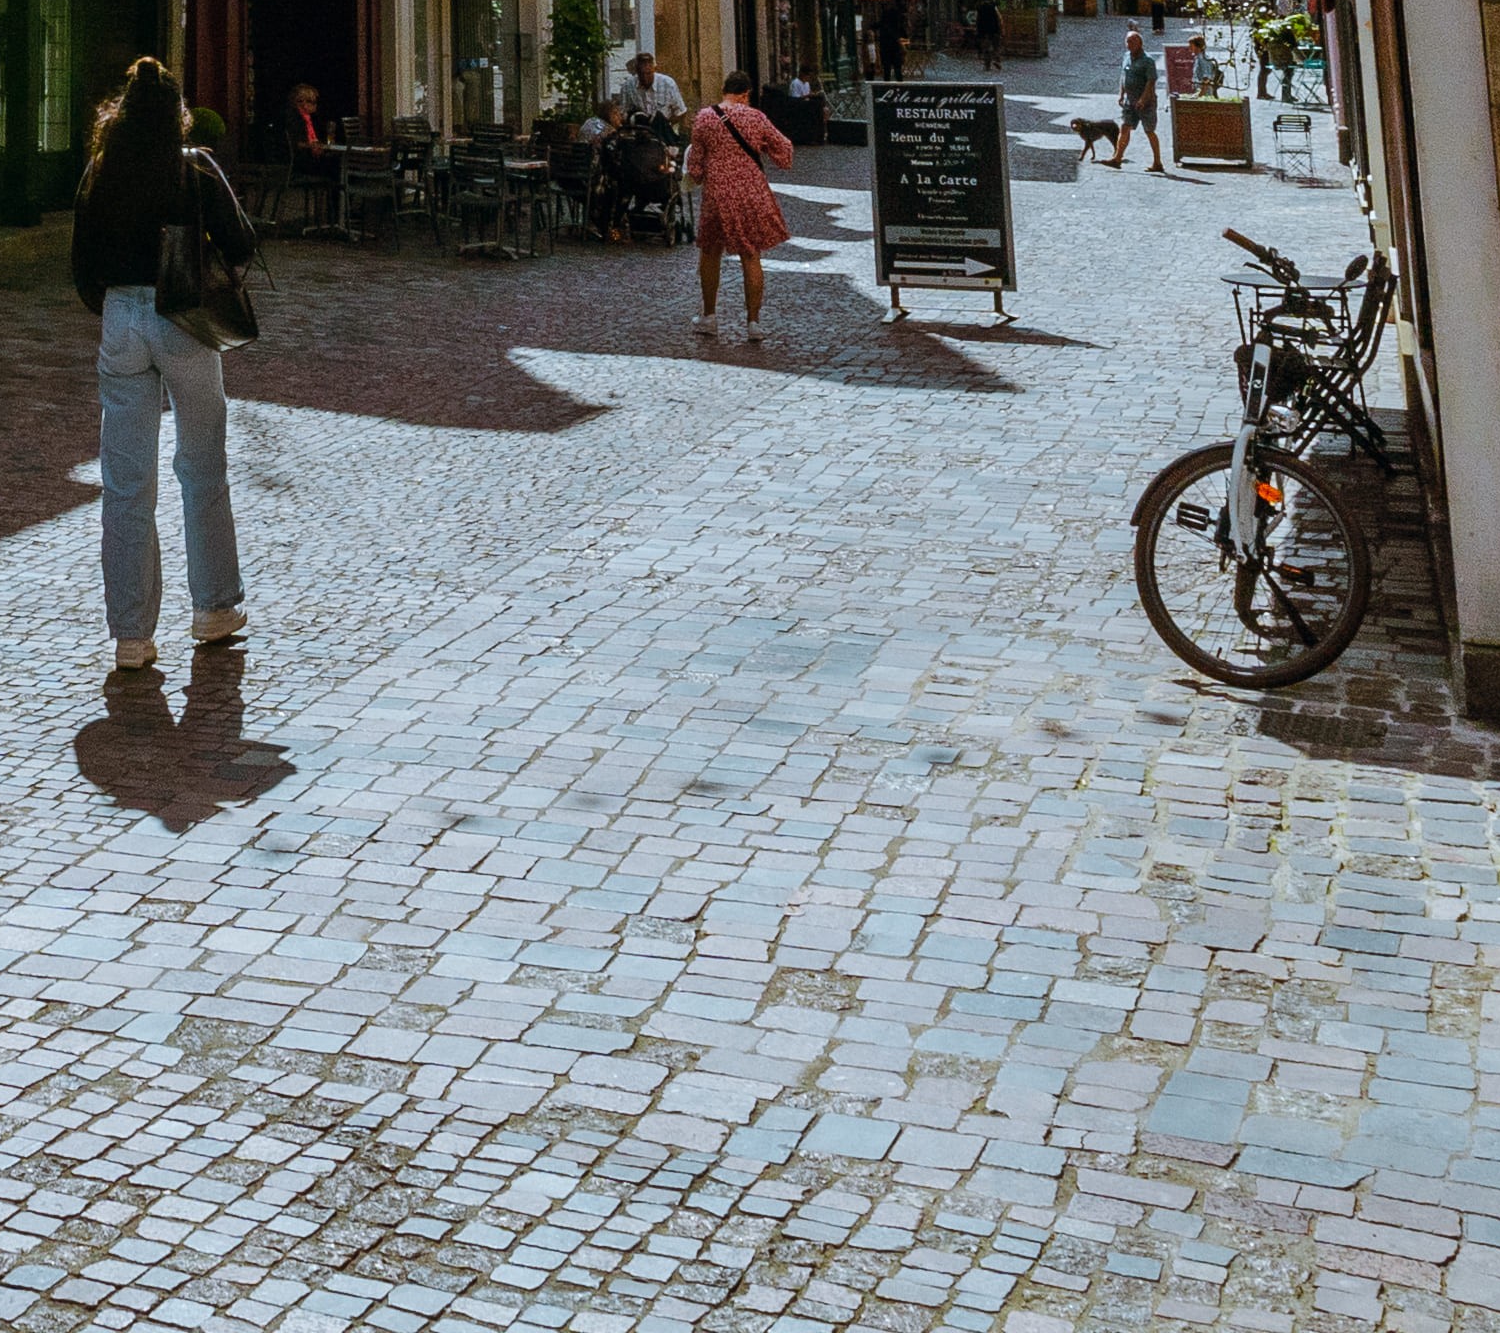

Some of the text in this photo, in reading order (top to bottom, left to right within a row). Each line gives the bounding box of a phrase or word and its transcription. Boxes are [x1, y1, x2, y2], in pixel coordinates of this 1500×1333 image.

[937, 91, 995, 109] grillades
[896, 108, 976, 120] RESTAURANT
[890, 131, 922, 143] Menu
[929, 131, 945, 143] du
[900, 173, 978, 186] A la Carte
